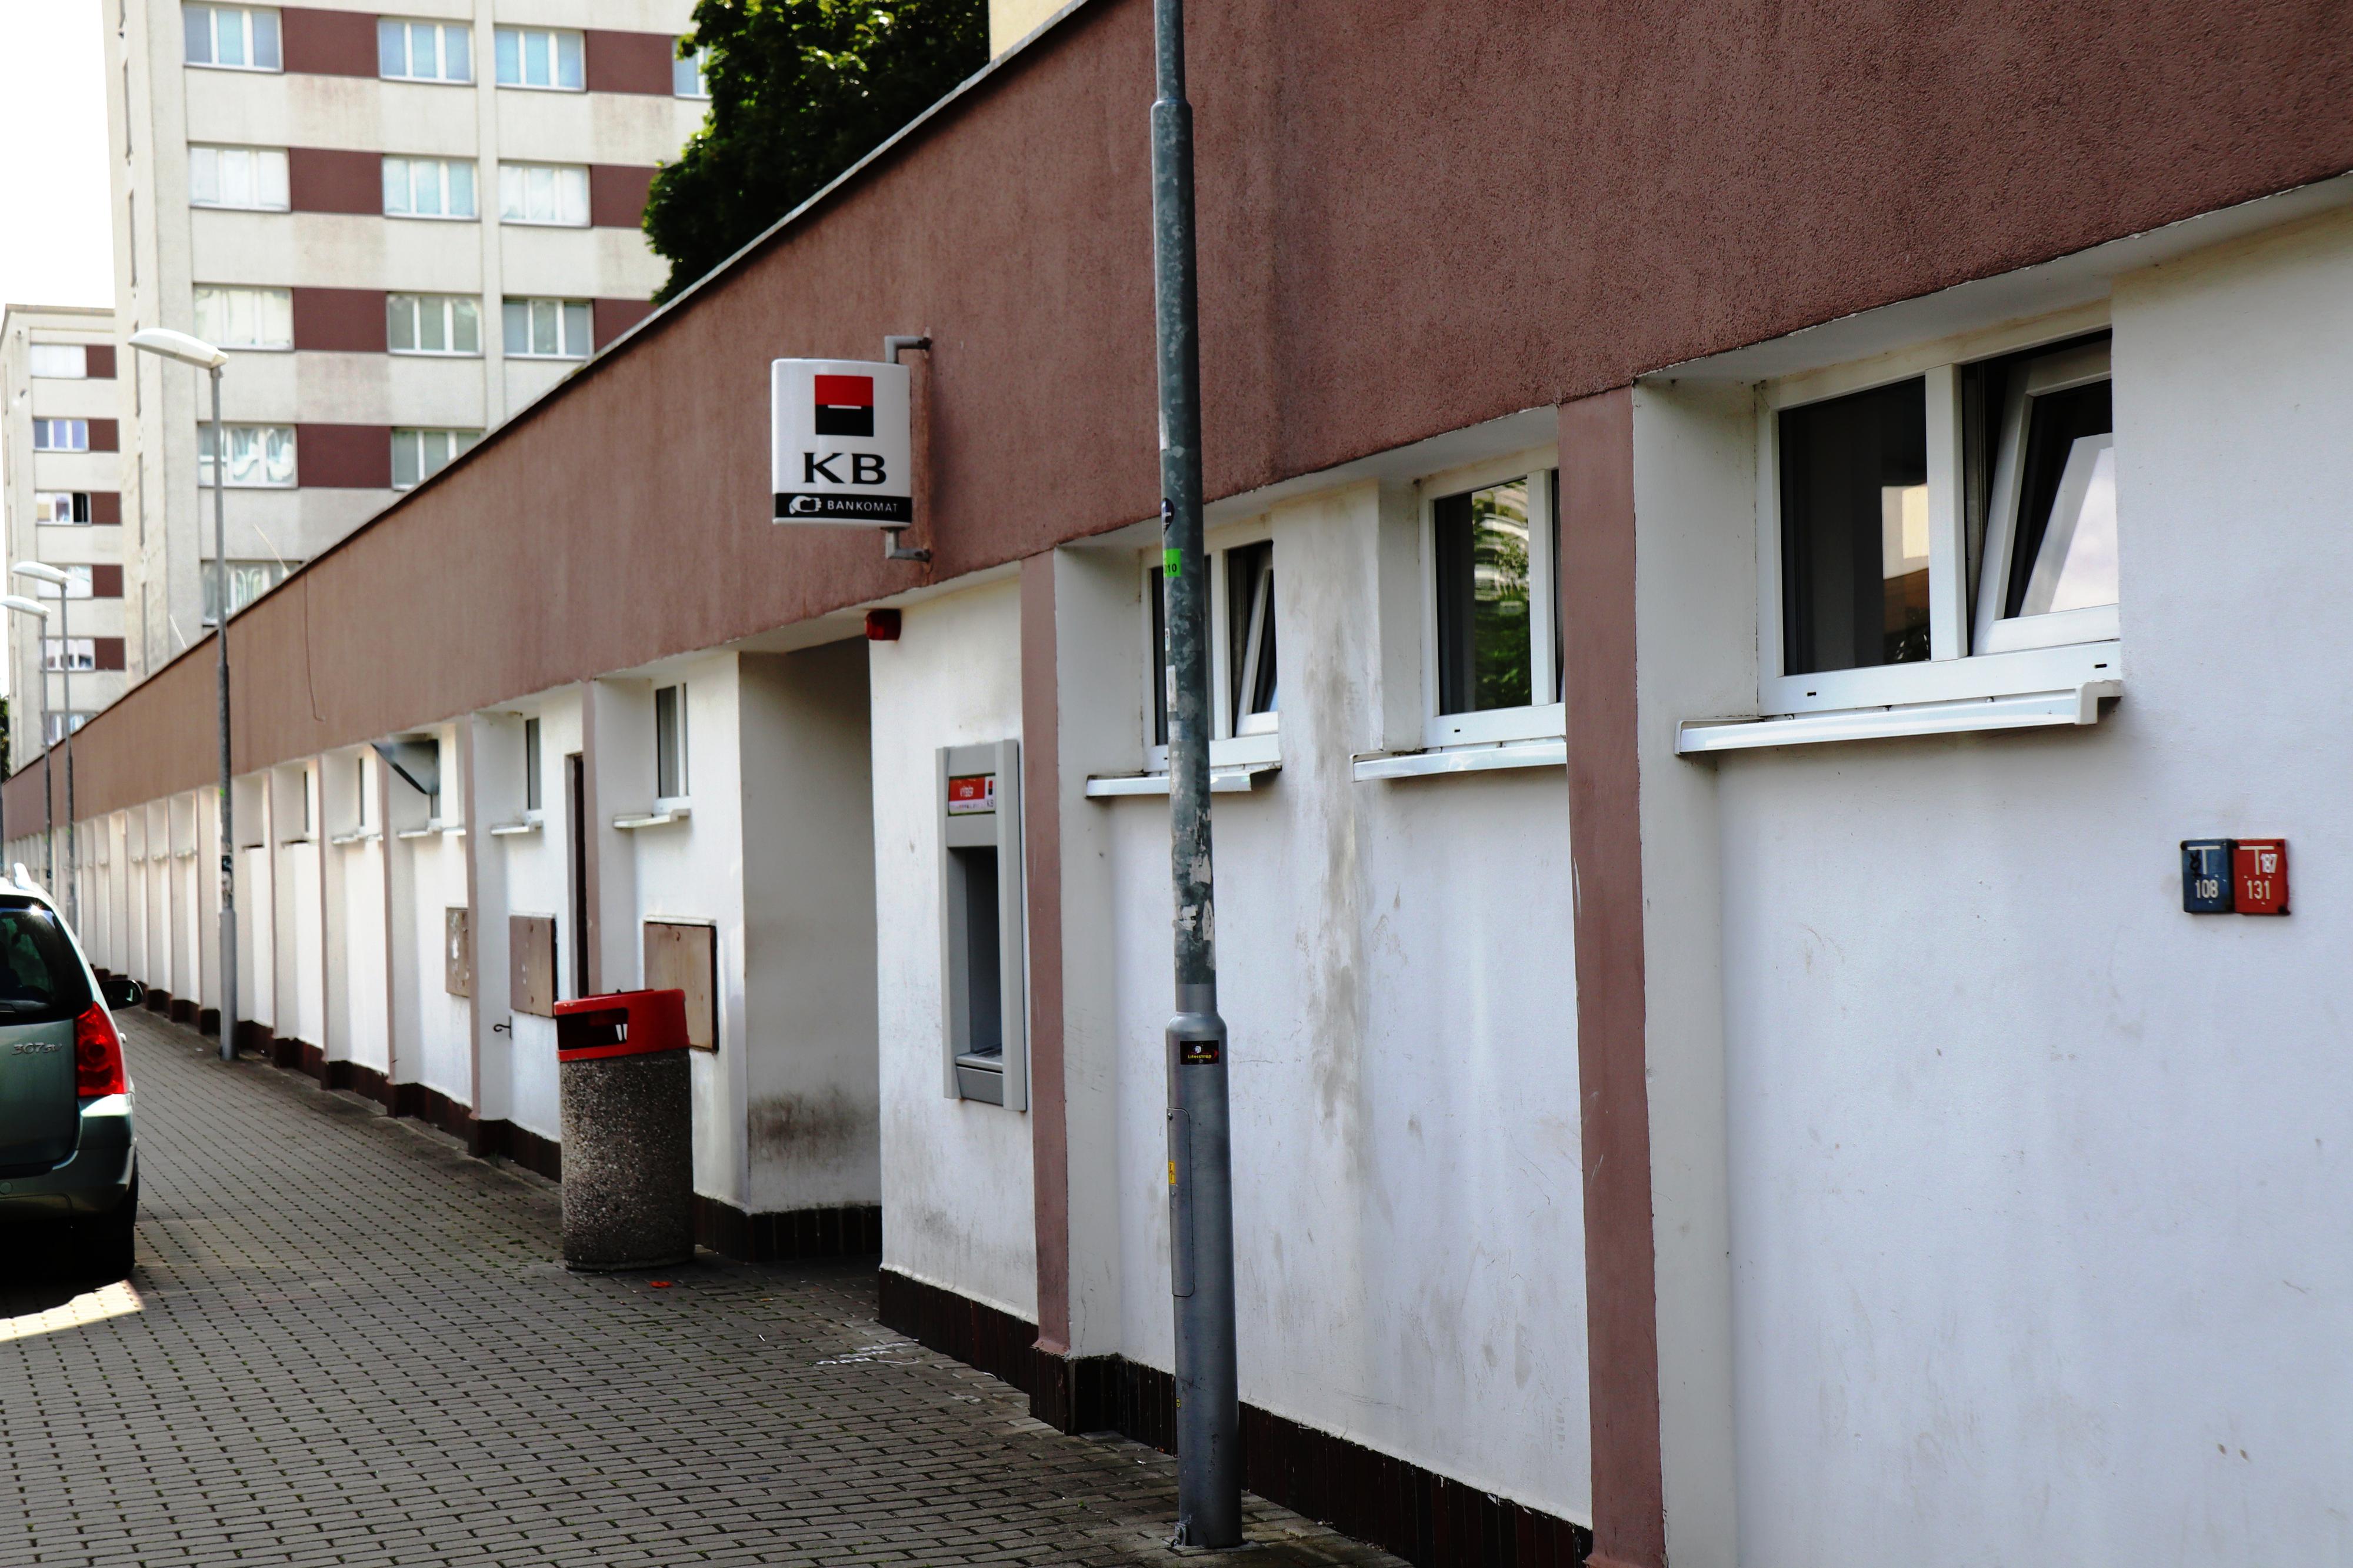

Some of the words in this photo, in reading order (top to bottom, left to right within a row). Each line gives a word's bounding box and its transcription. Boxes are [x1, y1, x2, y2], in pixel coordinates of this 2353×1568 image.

[803, 452, 887, 485] KB
[827, 499, 899, 512] BANKOMAT
[2187, 845, 2221, 875] T
[2239, 845, 2275, 875] T
[2195, 879, 2219, 899] 108
[2247, 879, 2271, 900] 131
